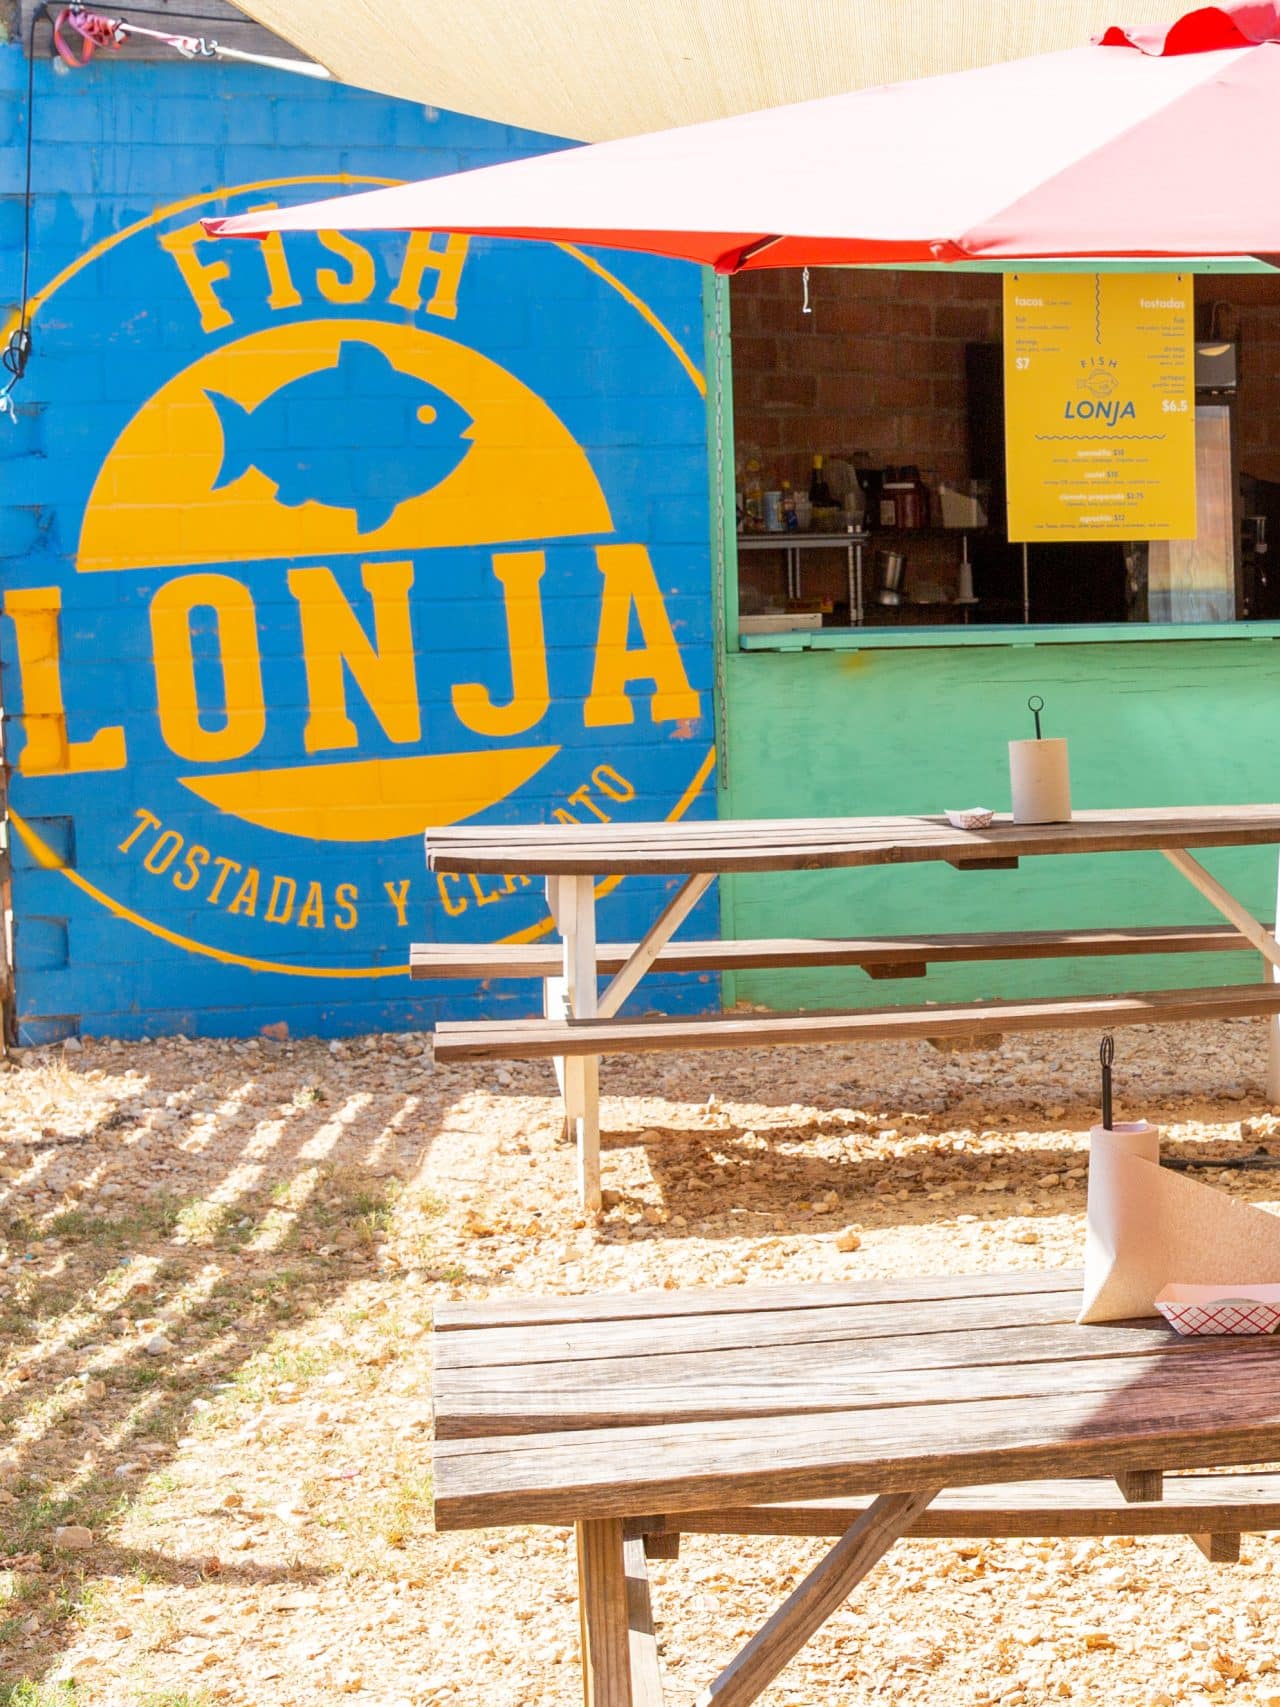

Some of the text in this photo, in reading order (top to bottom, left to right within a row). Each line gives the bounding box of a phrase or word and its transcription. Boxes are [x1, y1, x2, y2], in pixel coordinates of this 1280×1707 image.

[158, 202, 471, 334] FISH
[1140, 298, 1185, 309] tostadas
[1016, 357, 1030, 370] $7
[1081, 355, 1118, 369] FISH
[1064, 400, 1136, 427] LONJA
[1162, 399, 1187, 413] $6.5
[3, 544, 702, 777] LONJA
[117, 764, 636, 931] TOSTADAS Y CLATO
